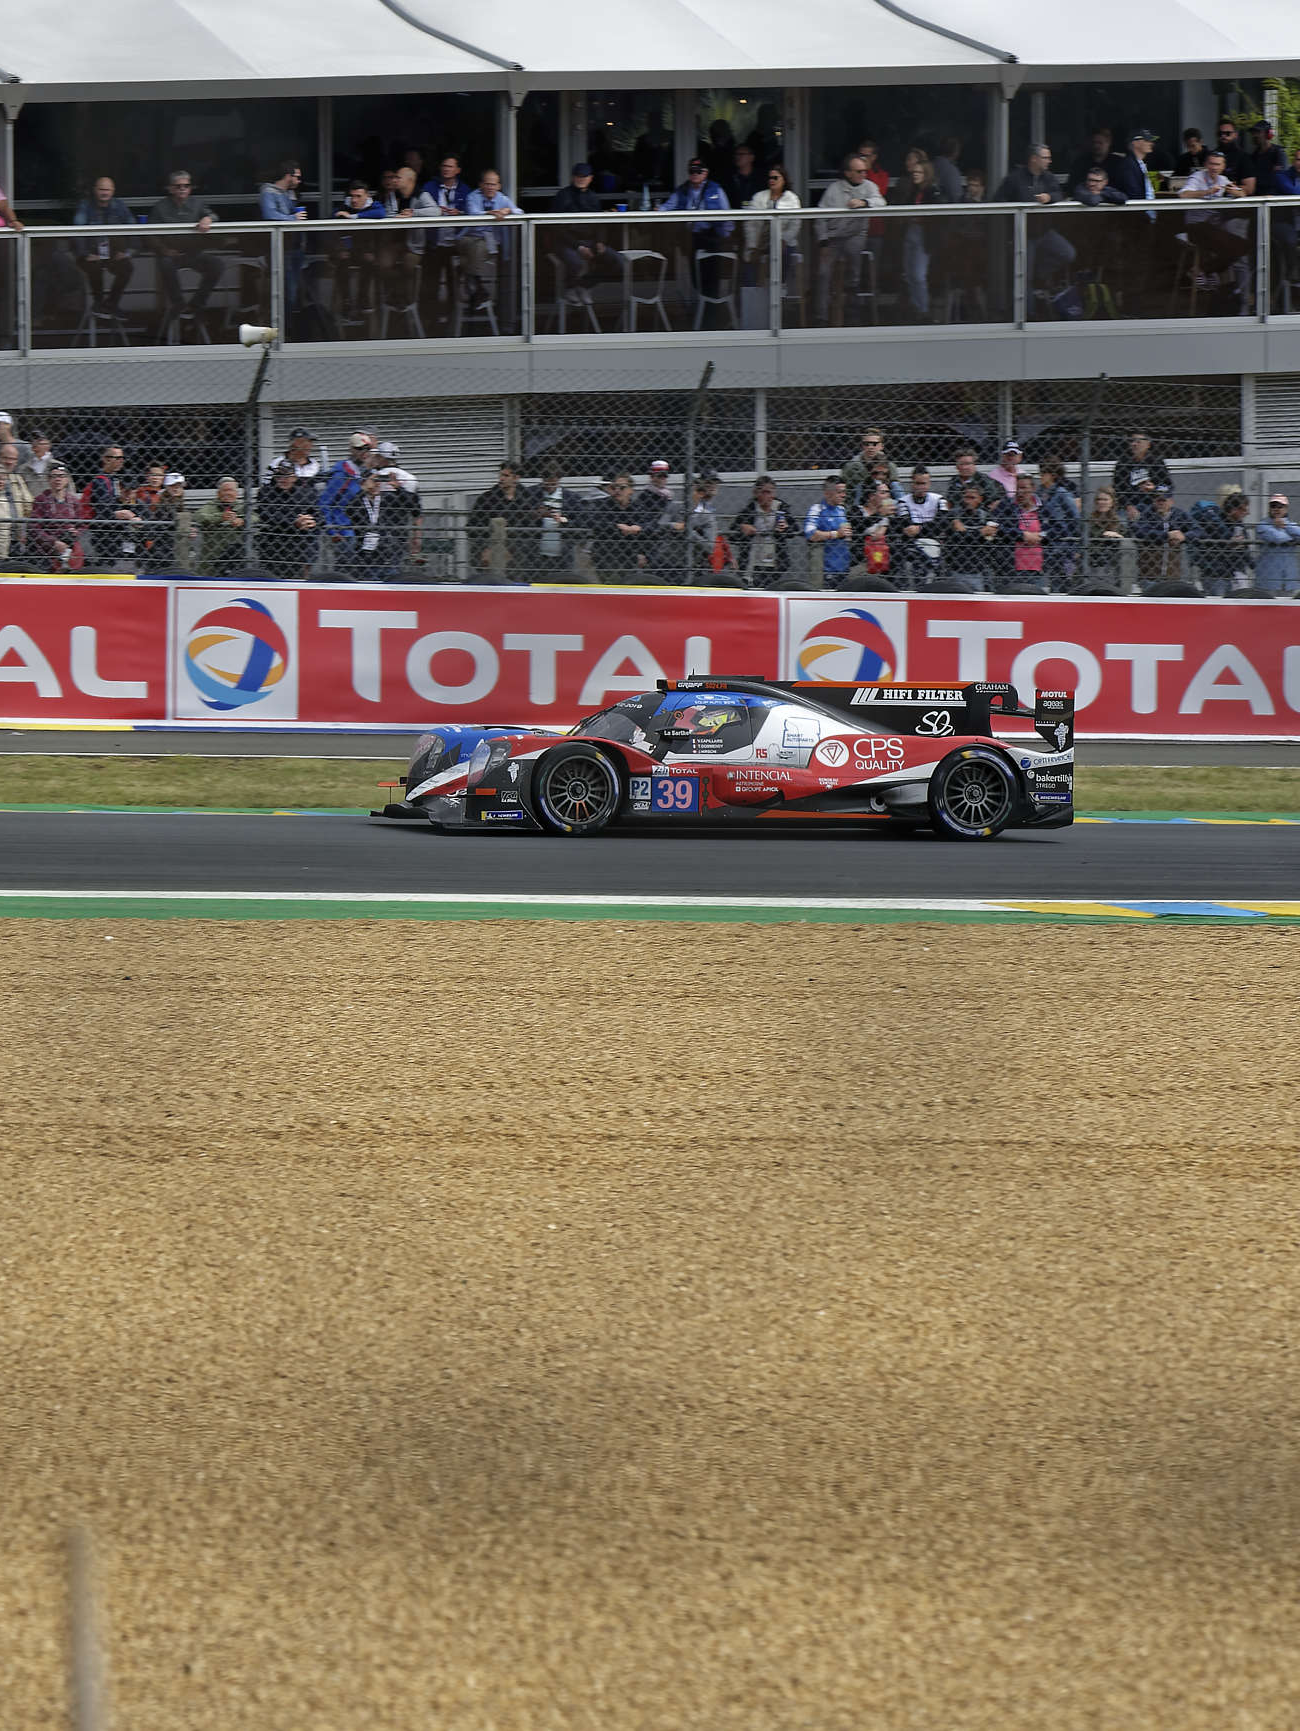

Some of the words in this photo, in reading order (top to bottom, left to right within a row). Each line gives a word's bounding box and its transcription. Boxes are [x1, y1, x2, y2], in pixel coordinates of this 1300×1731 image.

[883, 689, 912, 700] HIFI
[917, 689, 964, 700] FILTER
[1043, 700, 1064, 709] ageas
[853, 737, 905, 759] CPS
[855, 760, 905, 770] QUALITY
[736, 770, 792, 781] INTENCIAL
[631, 780, 649, 796] P2
[657, 780, 693, 809] 39
